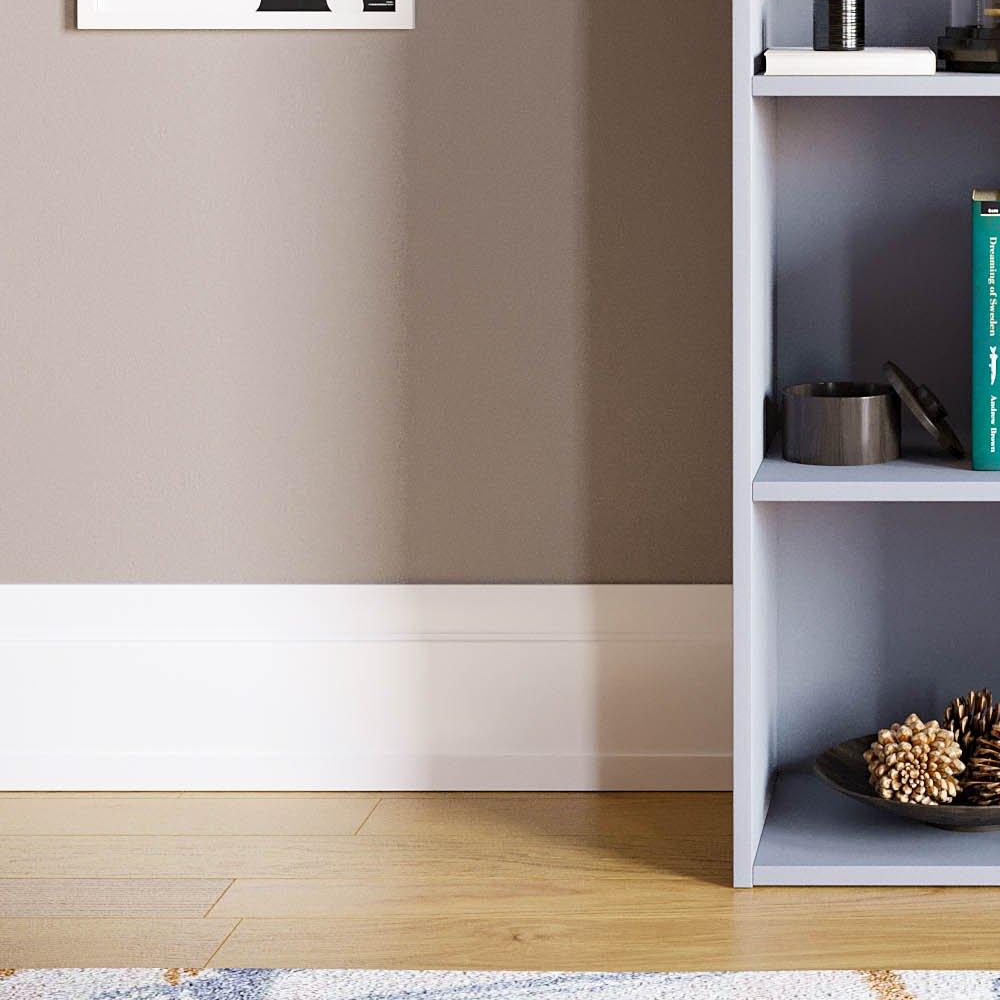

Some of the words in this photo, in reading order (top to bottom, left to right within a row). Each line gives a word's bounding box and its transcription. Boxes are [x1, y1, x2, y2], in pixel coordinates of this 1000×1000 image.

[988, 237, 997, 284] Dreaming
[988, 287, 997, 297] of
[989, 299, 997, 336] Sweden
